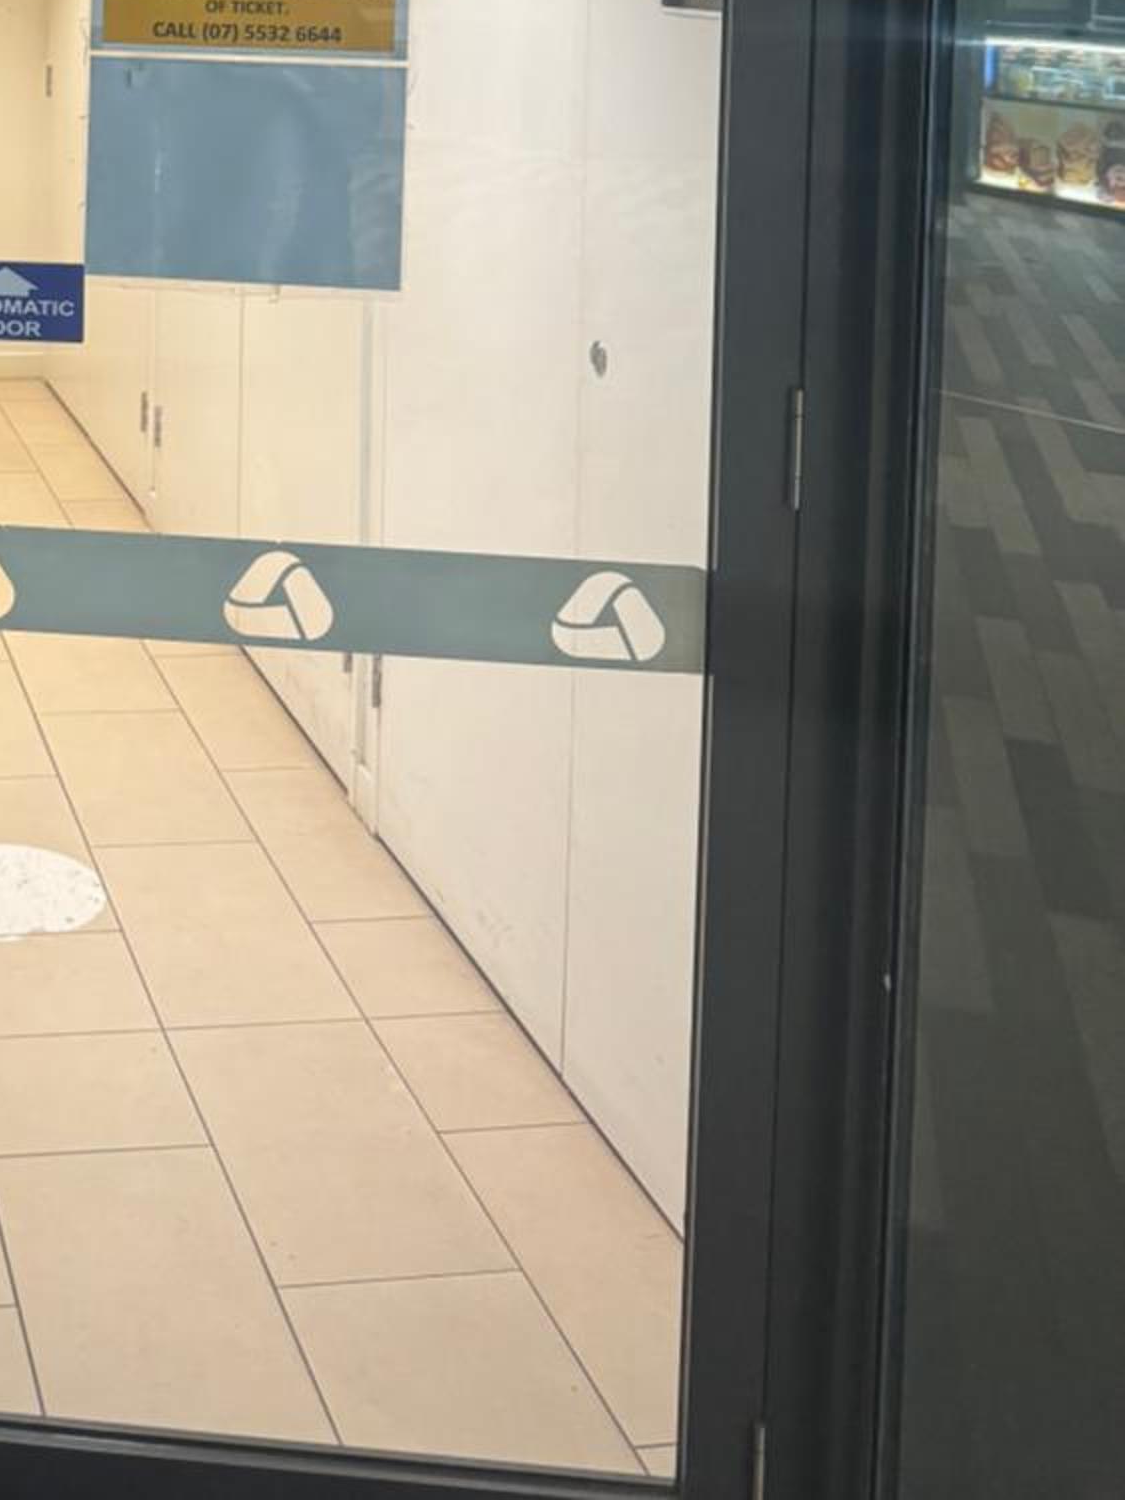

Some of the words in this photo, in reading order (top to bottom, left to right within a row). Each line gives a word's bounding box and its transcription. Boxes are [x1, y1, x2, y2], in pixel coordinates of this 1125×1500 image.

[205, 0, 225, 14] OF
[230, 1, 290, 15] TICKET.
[152, 22, 197, 40] CALL
[202, 23, 239, 42] (07)
[244, 24, 289, 41] 5532
[295, 26, 342, 42] 6644
